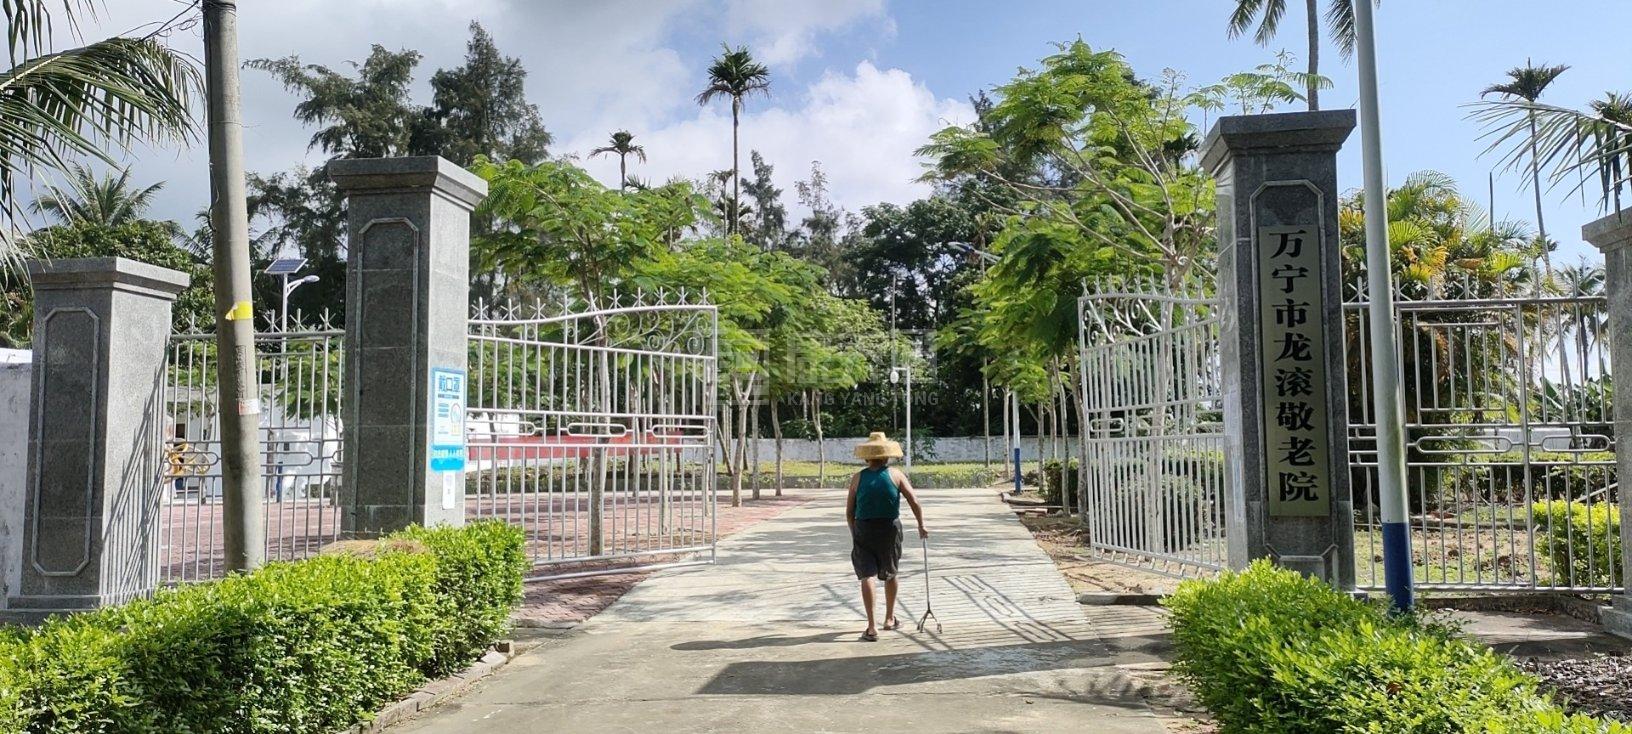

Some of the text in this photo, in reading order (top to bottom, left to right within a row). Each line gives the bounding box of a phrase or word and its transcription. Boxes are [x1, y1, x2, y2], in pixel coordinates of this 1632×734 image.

[1269, 229, 1319, 502] 万宁市龙滚敬老院
